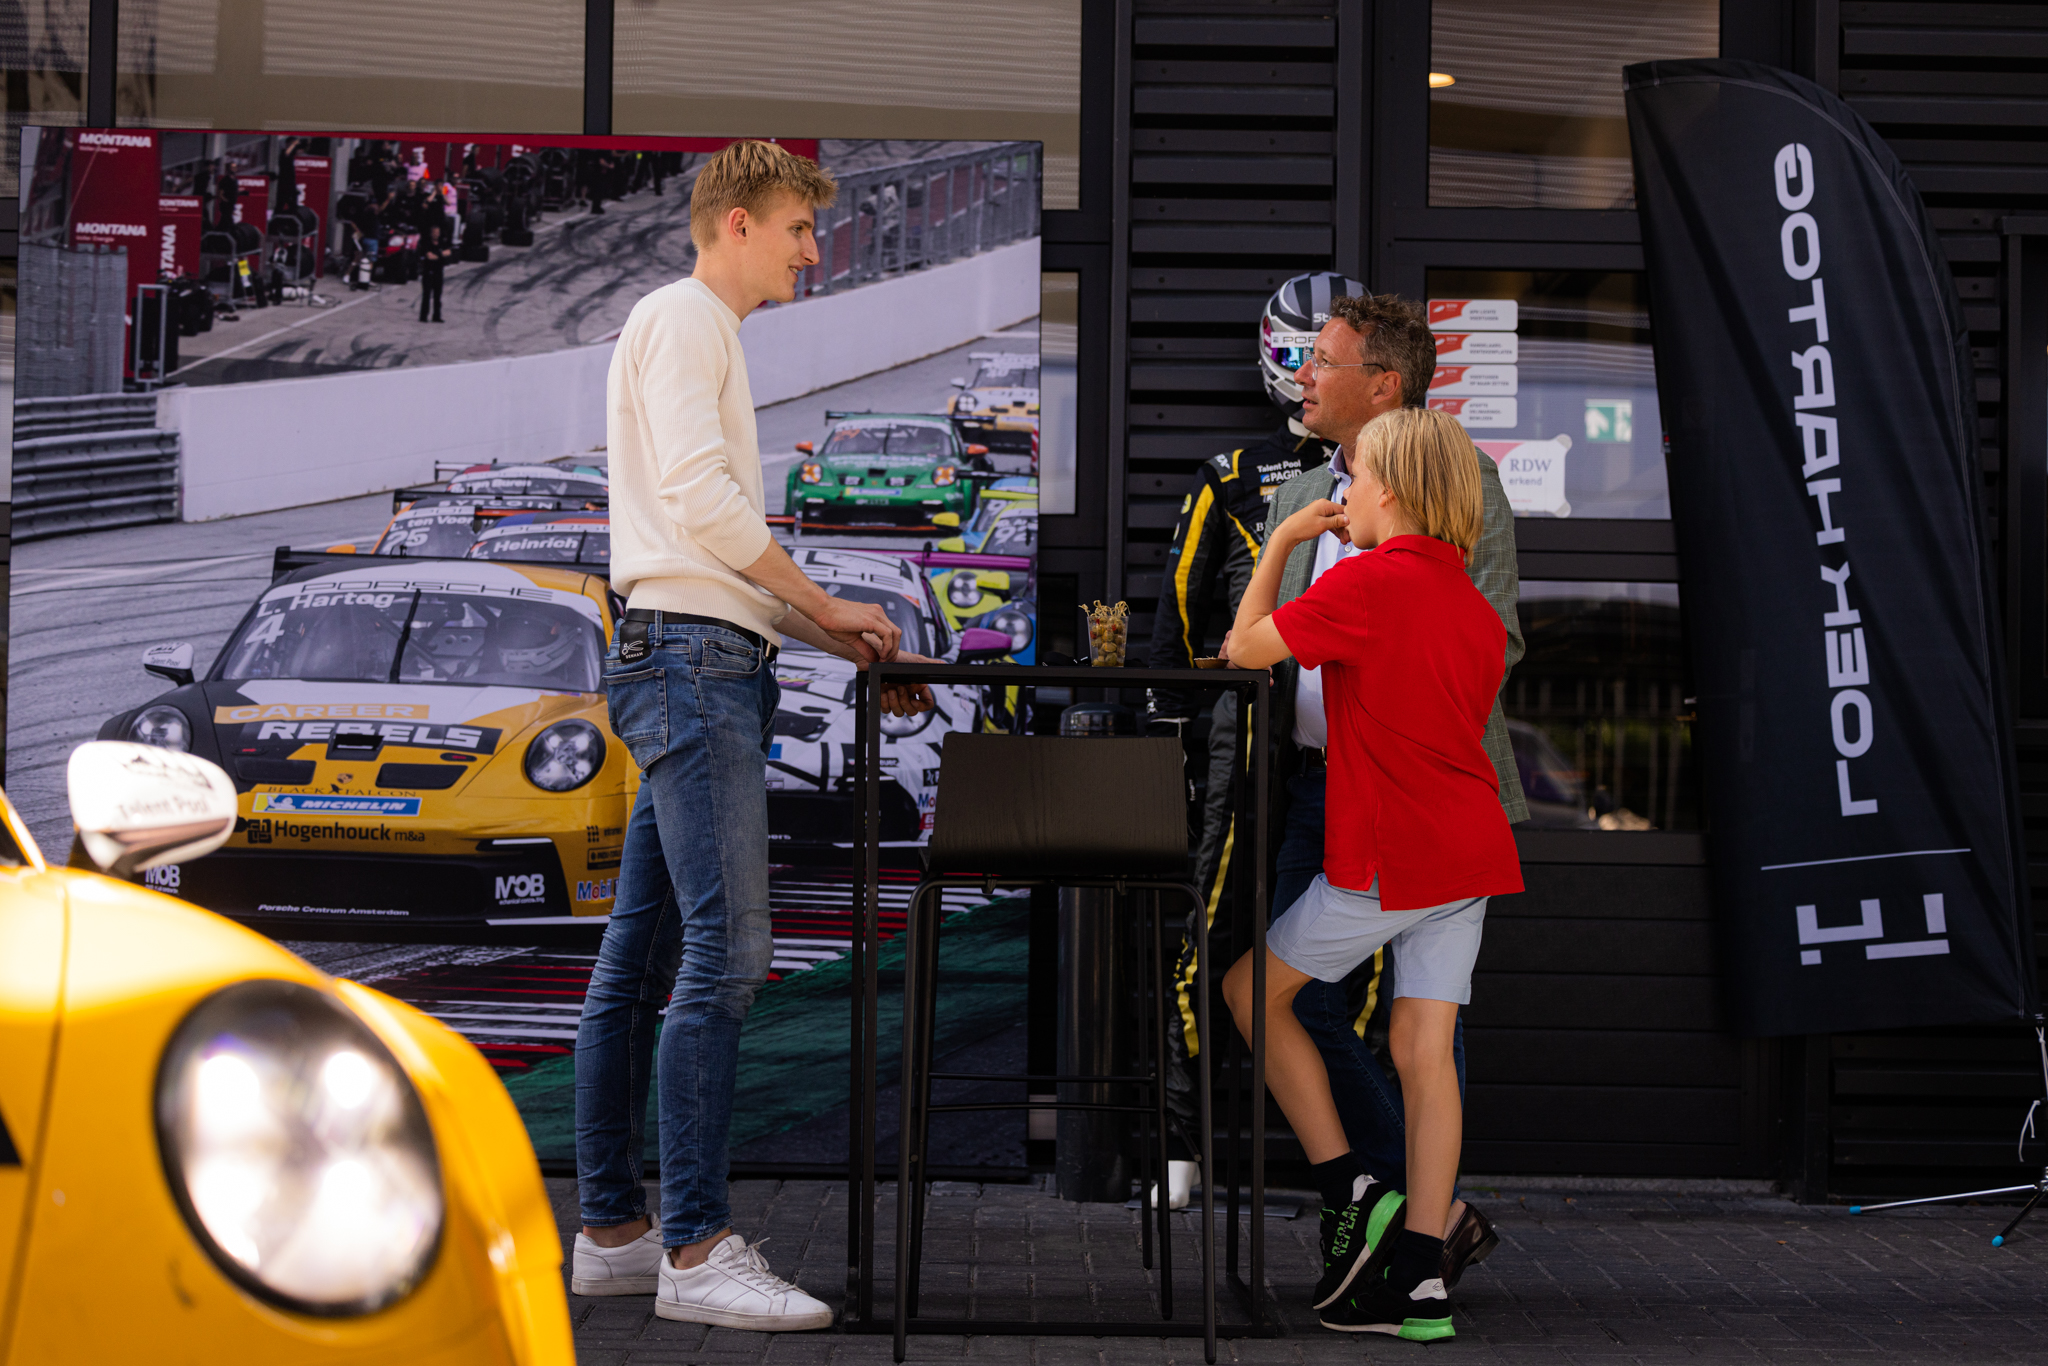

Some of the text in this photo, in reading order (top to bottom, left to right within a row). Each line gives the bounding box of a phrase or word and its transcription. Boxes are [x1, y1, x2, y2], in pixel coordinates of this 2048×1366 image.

[79, 133, 152, 148] MONTANA
[76, 222, 147, 237] MONTANA
[1313, 312, 1331, 323] St
[1257, 459, 1301, 473] Talent Pool
[1509, 458, 1552, 472] RDW
[1270, 468, 1303, 482] PAGID
[1509, 476, 1543, 486] erkend
[407, 516, 434, 527] ten
[387, 527, 431, 553] 25
[493, 537, 579, 553] Heinrich
[301, 581, 554, 601] PORSCHE
[256, 592, 395, 619] L. Hartog
[245, 612, 286, 645] 4
[230, 704, 416, 721] CAREER
[257, 721, 483, 749] REBELS
[267, 786, 417, 798] BLACK FALCON
[301, 799, 407, 811] MICHELIN
[275, 820, 425, 843] Hogenhouck m&a
[145, 864, 181, 888] MOB
[495, 873, 546, 899] MOB
[576, 878, 612, 902] Mobil
[258, 903, 410, 917] Porsche Centrum Amsterdam
[1332, 1205, 1360, 1257] REPLAY
